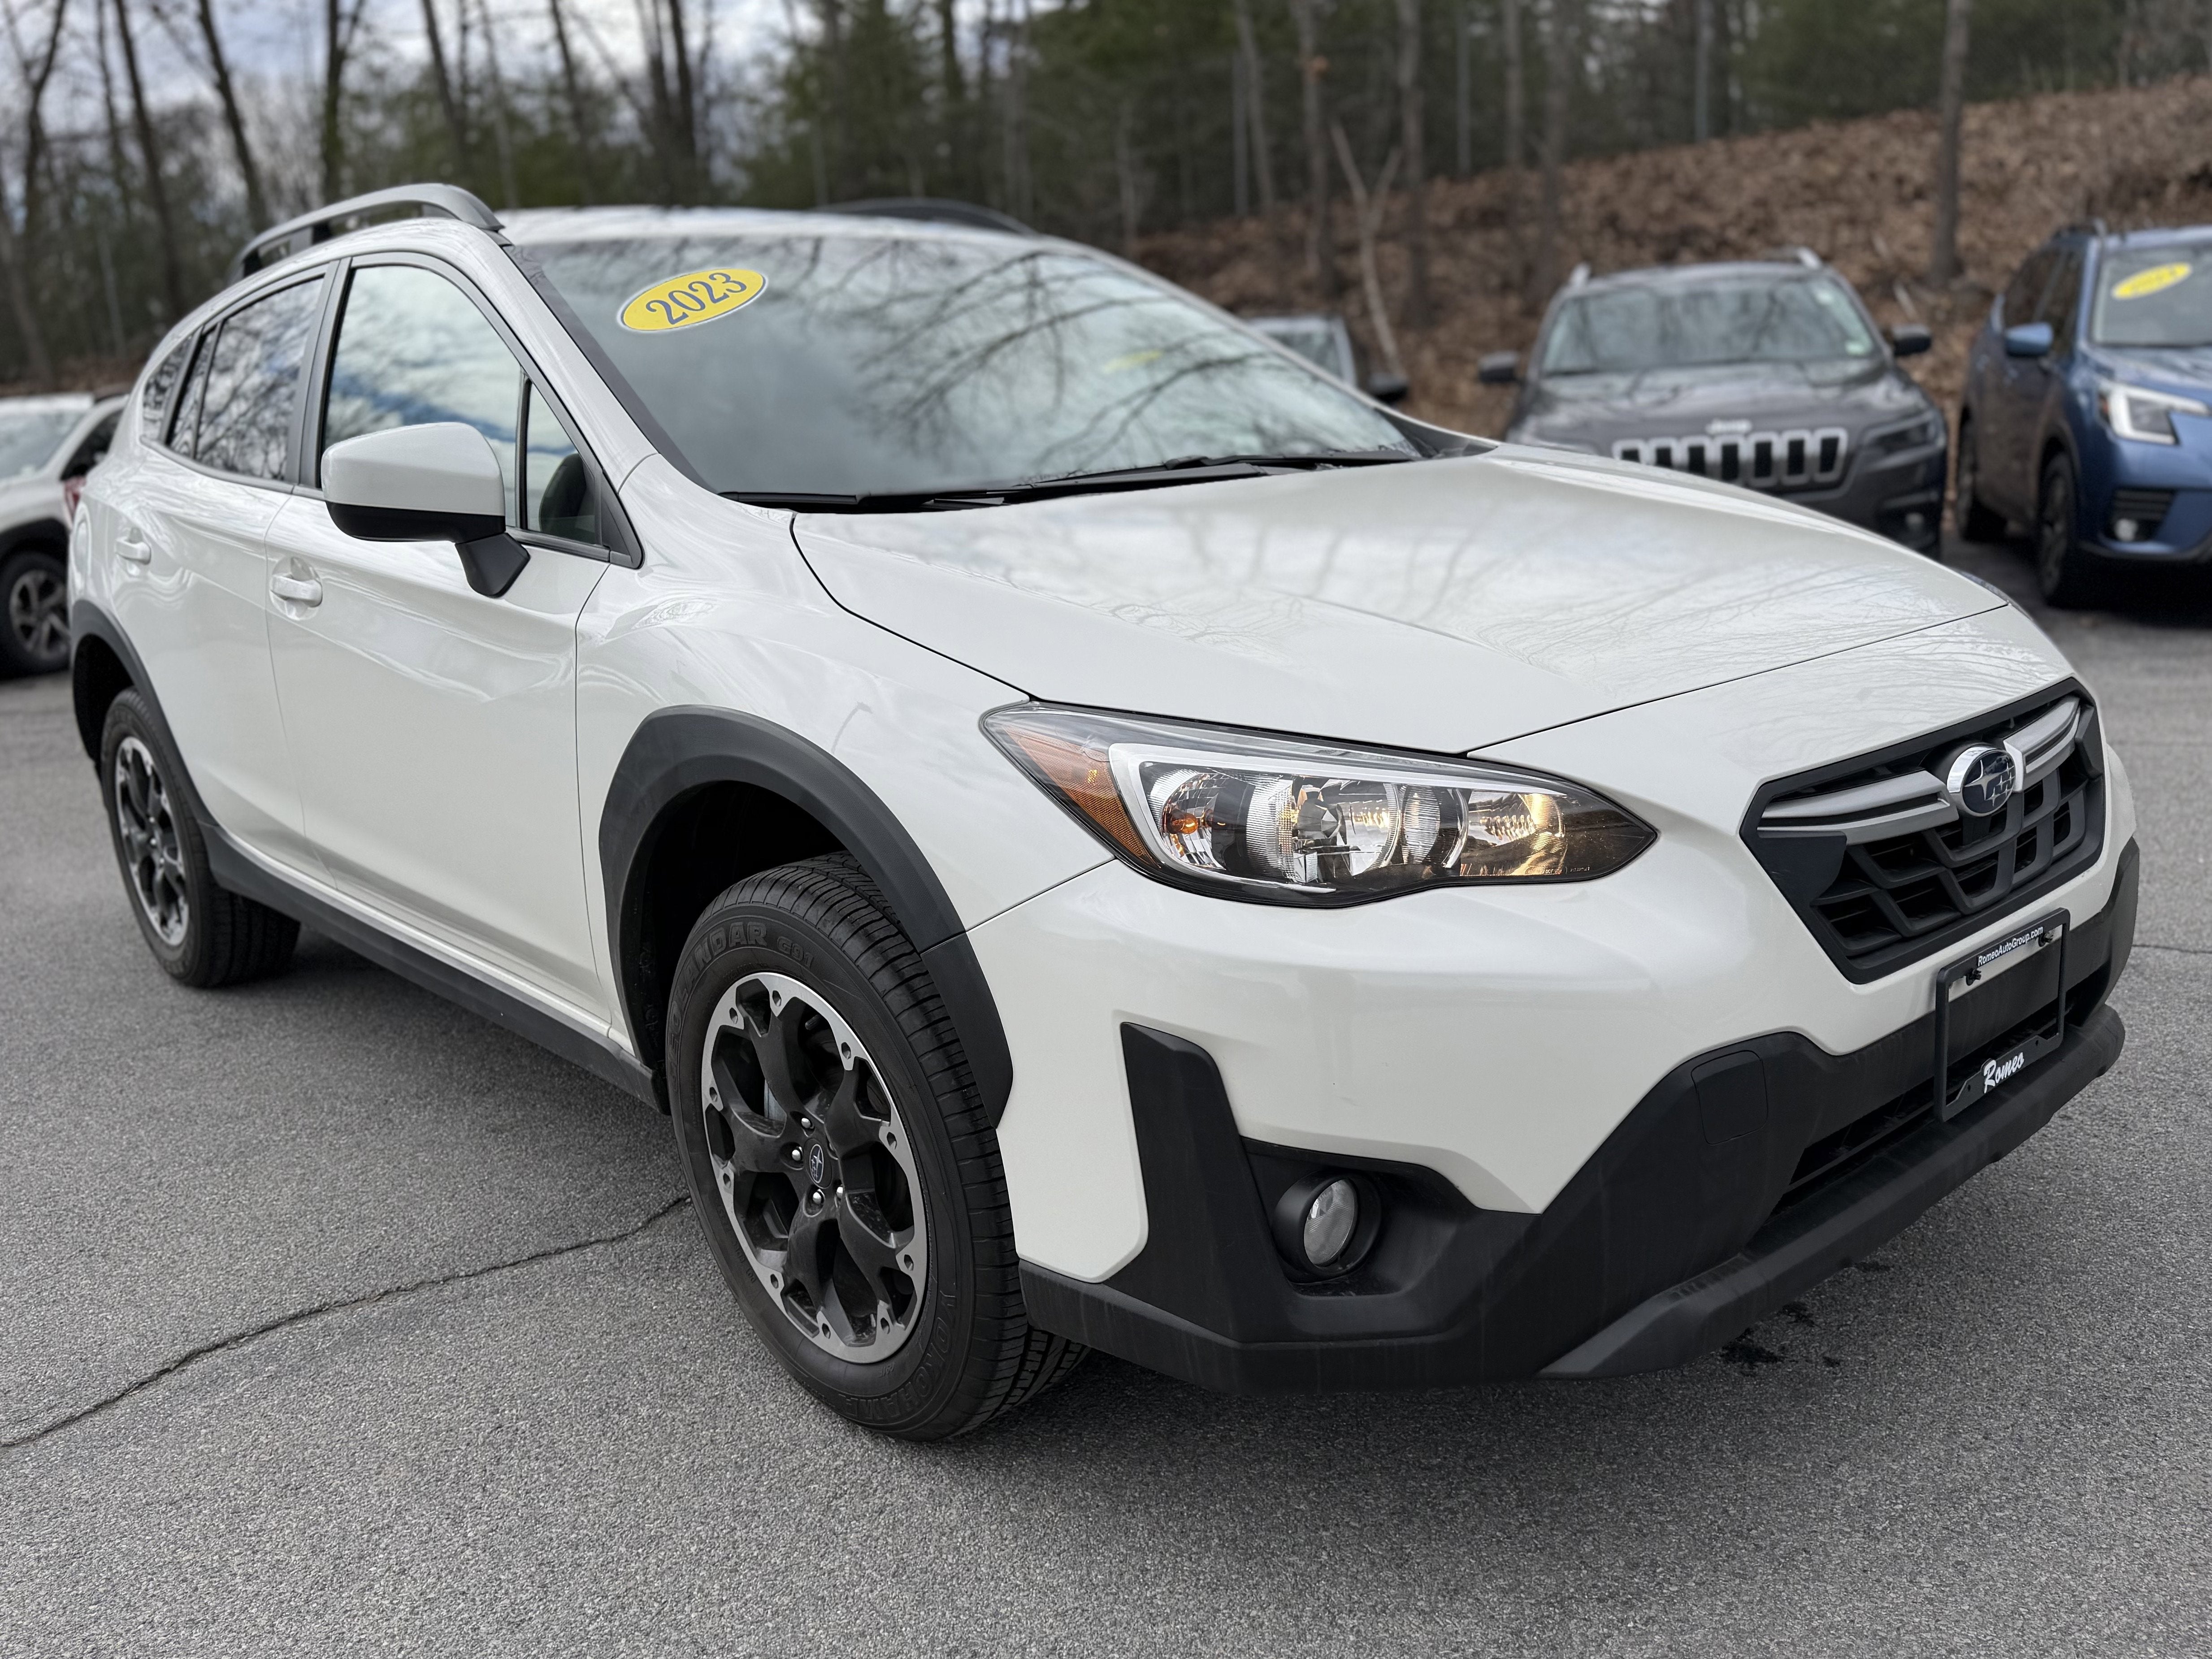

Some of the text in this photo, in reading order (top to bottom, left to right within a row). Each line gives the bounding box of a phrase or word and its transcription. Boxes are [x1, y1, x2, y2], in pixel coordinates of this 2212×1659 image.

[646, 273, 746, 325] 2023
[777, 936, 814, 969] G91
[1978, 927, 2043, 966] RomeoAutoGroup.com
[1983, 1052, 2024, 1093] Romeo
